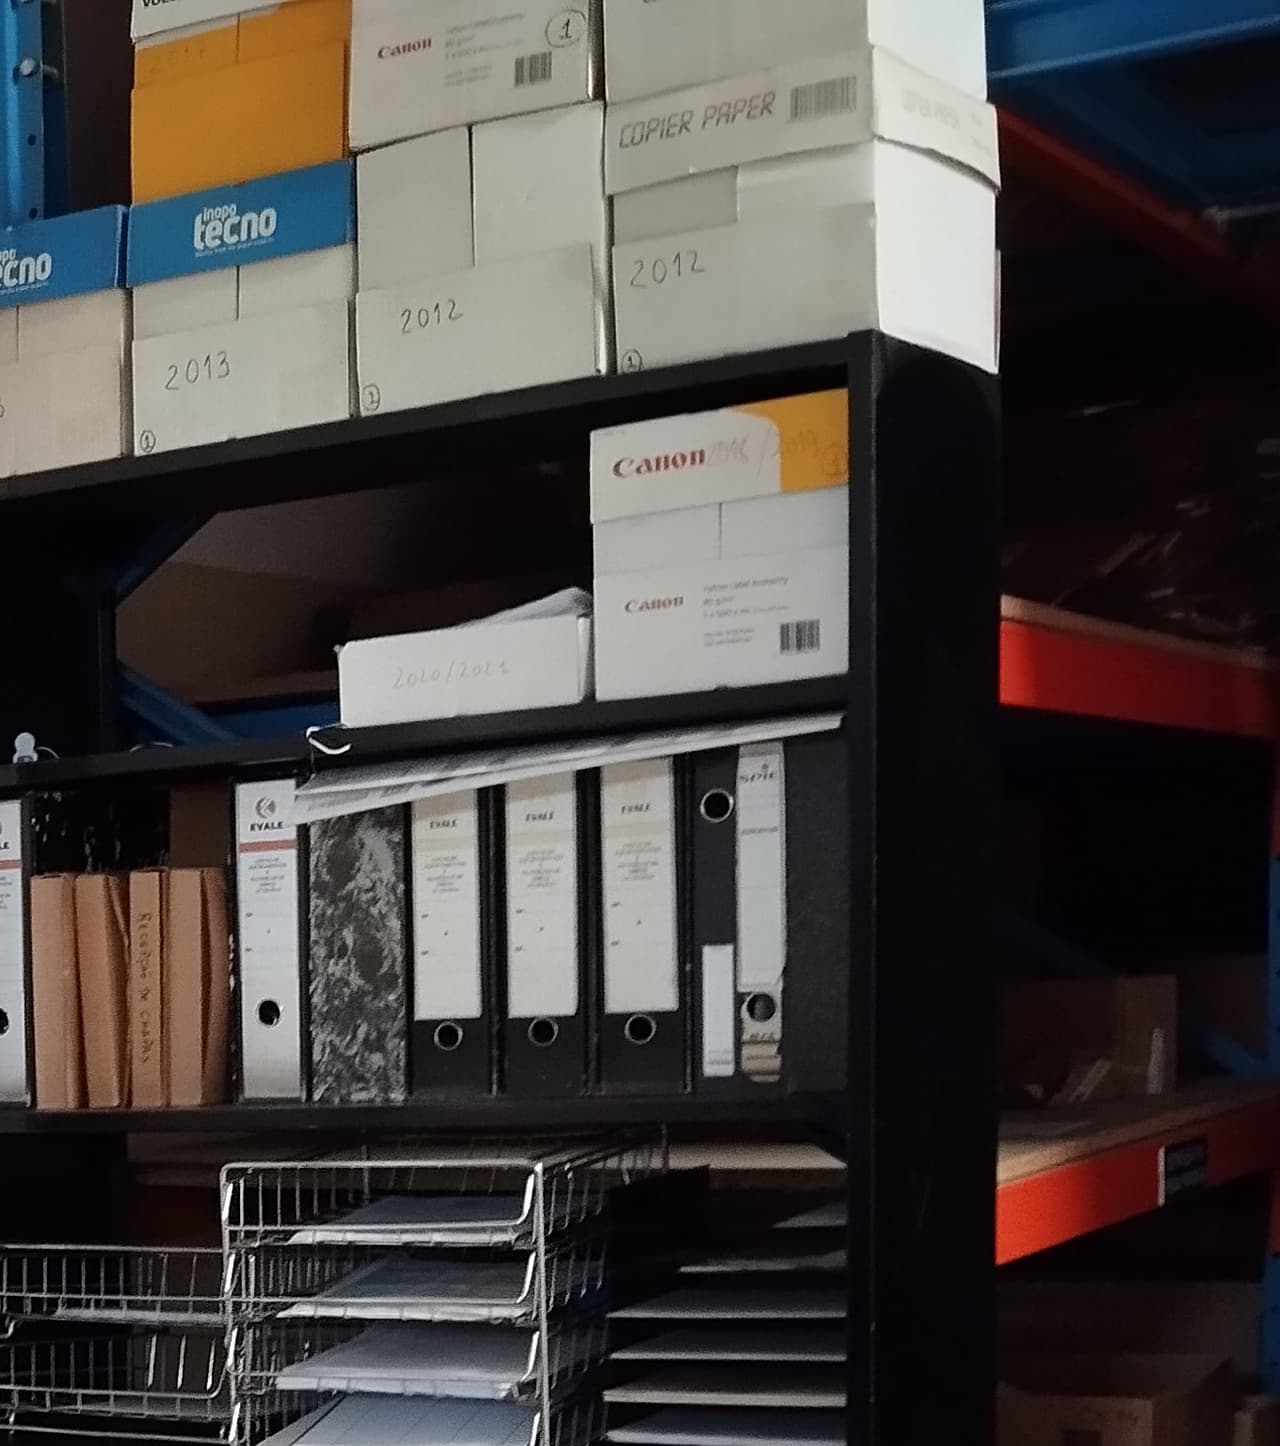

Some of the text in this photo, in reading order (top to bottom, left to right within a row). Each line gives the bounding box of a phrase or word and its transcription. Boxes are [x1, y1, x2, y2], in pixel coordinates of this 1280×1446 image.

[377, 37, 433, 61] Canon
[618, 91, 776, 150] COPIER PAPER
[193, 207, 277, 251] tecno
[629, 249, 706, 289] 2012
[400, 299, 464, 334] 2012
[164, 350, 231, 391] 2013
[611, 446, 706, 479] Canon
[624, 594, 685, 615] Canon
[249, 820, 284, 833] EVALE
